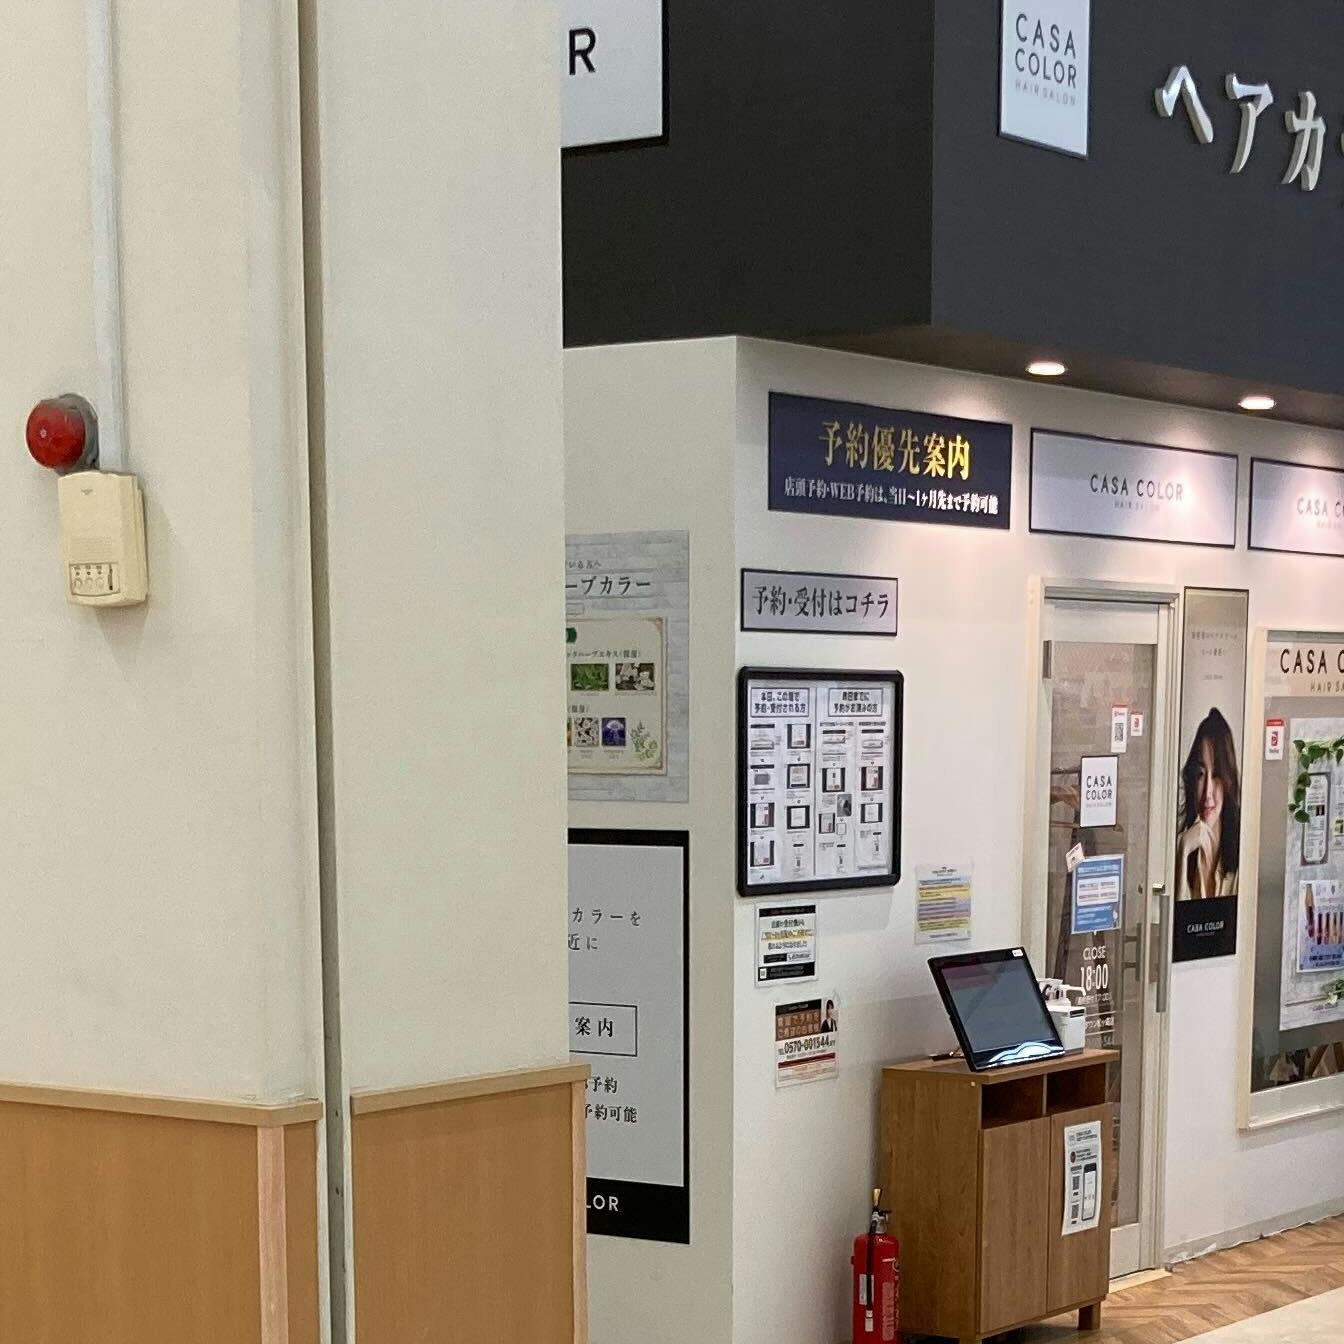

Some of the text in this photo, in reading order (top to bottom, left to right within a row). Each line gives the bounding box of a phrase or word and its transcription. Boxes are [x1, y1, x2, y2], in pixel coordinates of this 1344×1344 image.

[1015, 13, 1076, 59] CASA
[567, 27, 597, 76] R
[1014, 48, 1077, 89] COLOR
[1015, 79, 1039, 97] HAIR
[818, 419, 971, 480] 予約優先案内
[1089, 473, 1184, 502] CASA COLOR
[1296, 497, 1329, 517] CASA
[752, 585, 889, 618] 予約・受付はコチラ
[1280, 648, 1328, 675] CASA
[1085, 789, 1113, 801] COLOR
[1086, 775, 1113, 788] CASA
[572, 907, 641, 927] カラーを
[1083, 945, 1106, 960] CLOSE
[1080, 963, 1109, 992] 18:00
[574, 1015, 615, 1038] 案内
